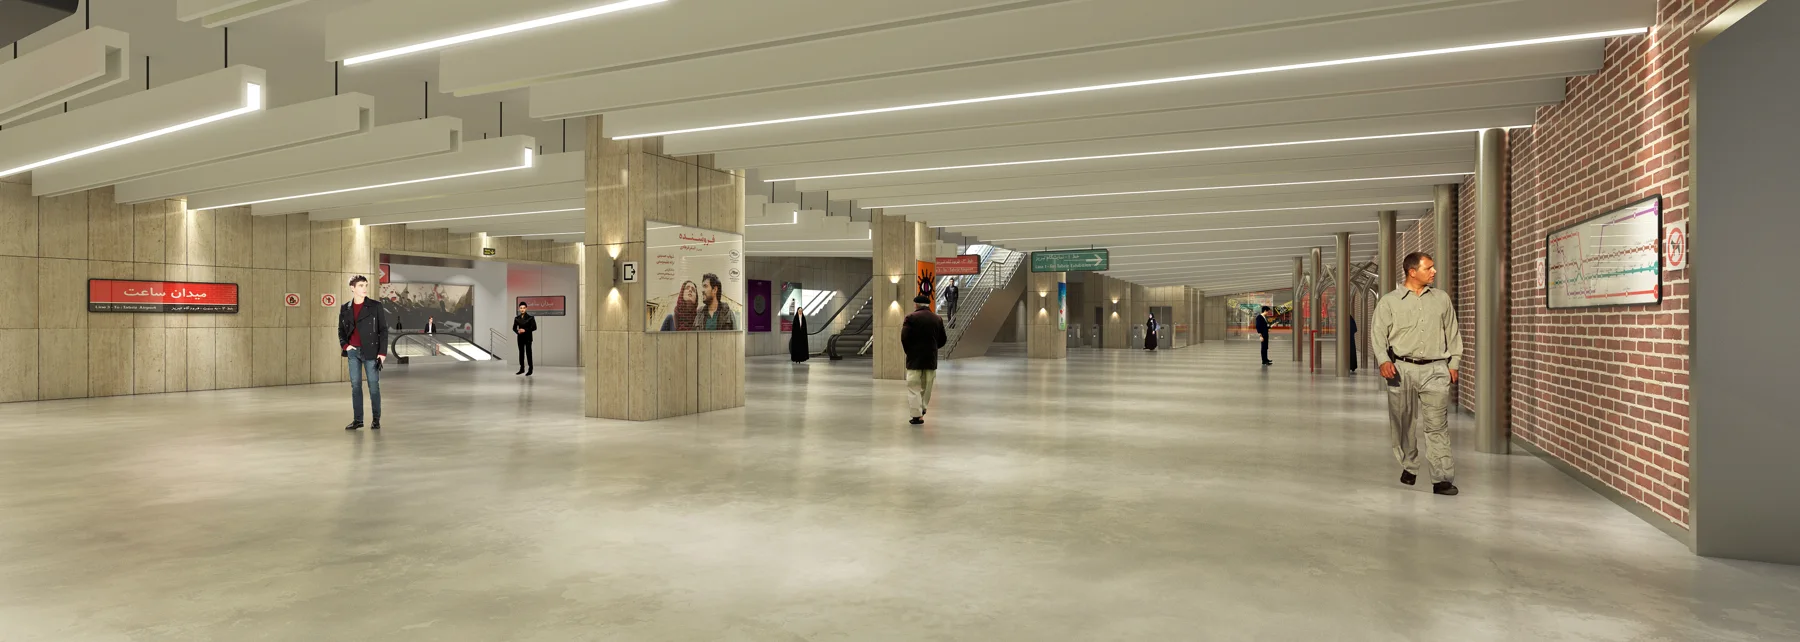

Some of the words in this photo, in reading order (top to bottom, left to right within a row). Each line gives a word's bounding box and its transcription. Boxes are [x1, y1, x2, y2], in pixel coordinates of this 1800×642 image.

[679, 233, 716, 243] فروشنده
[123, 287, 166, 297] ساعت
[171, 287, 207, 300] میدان
